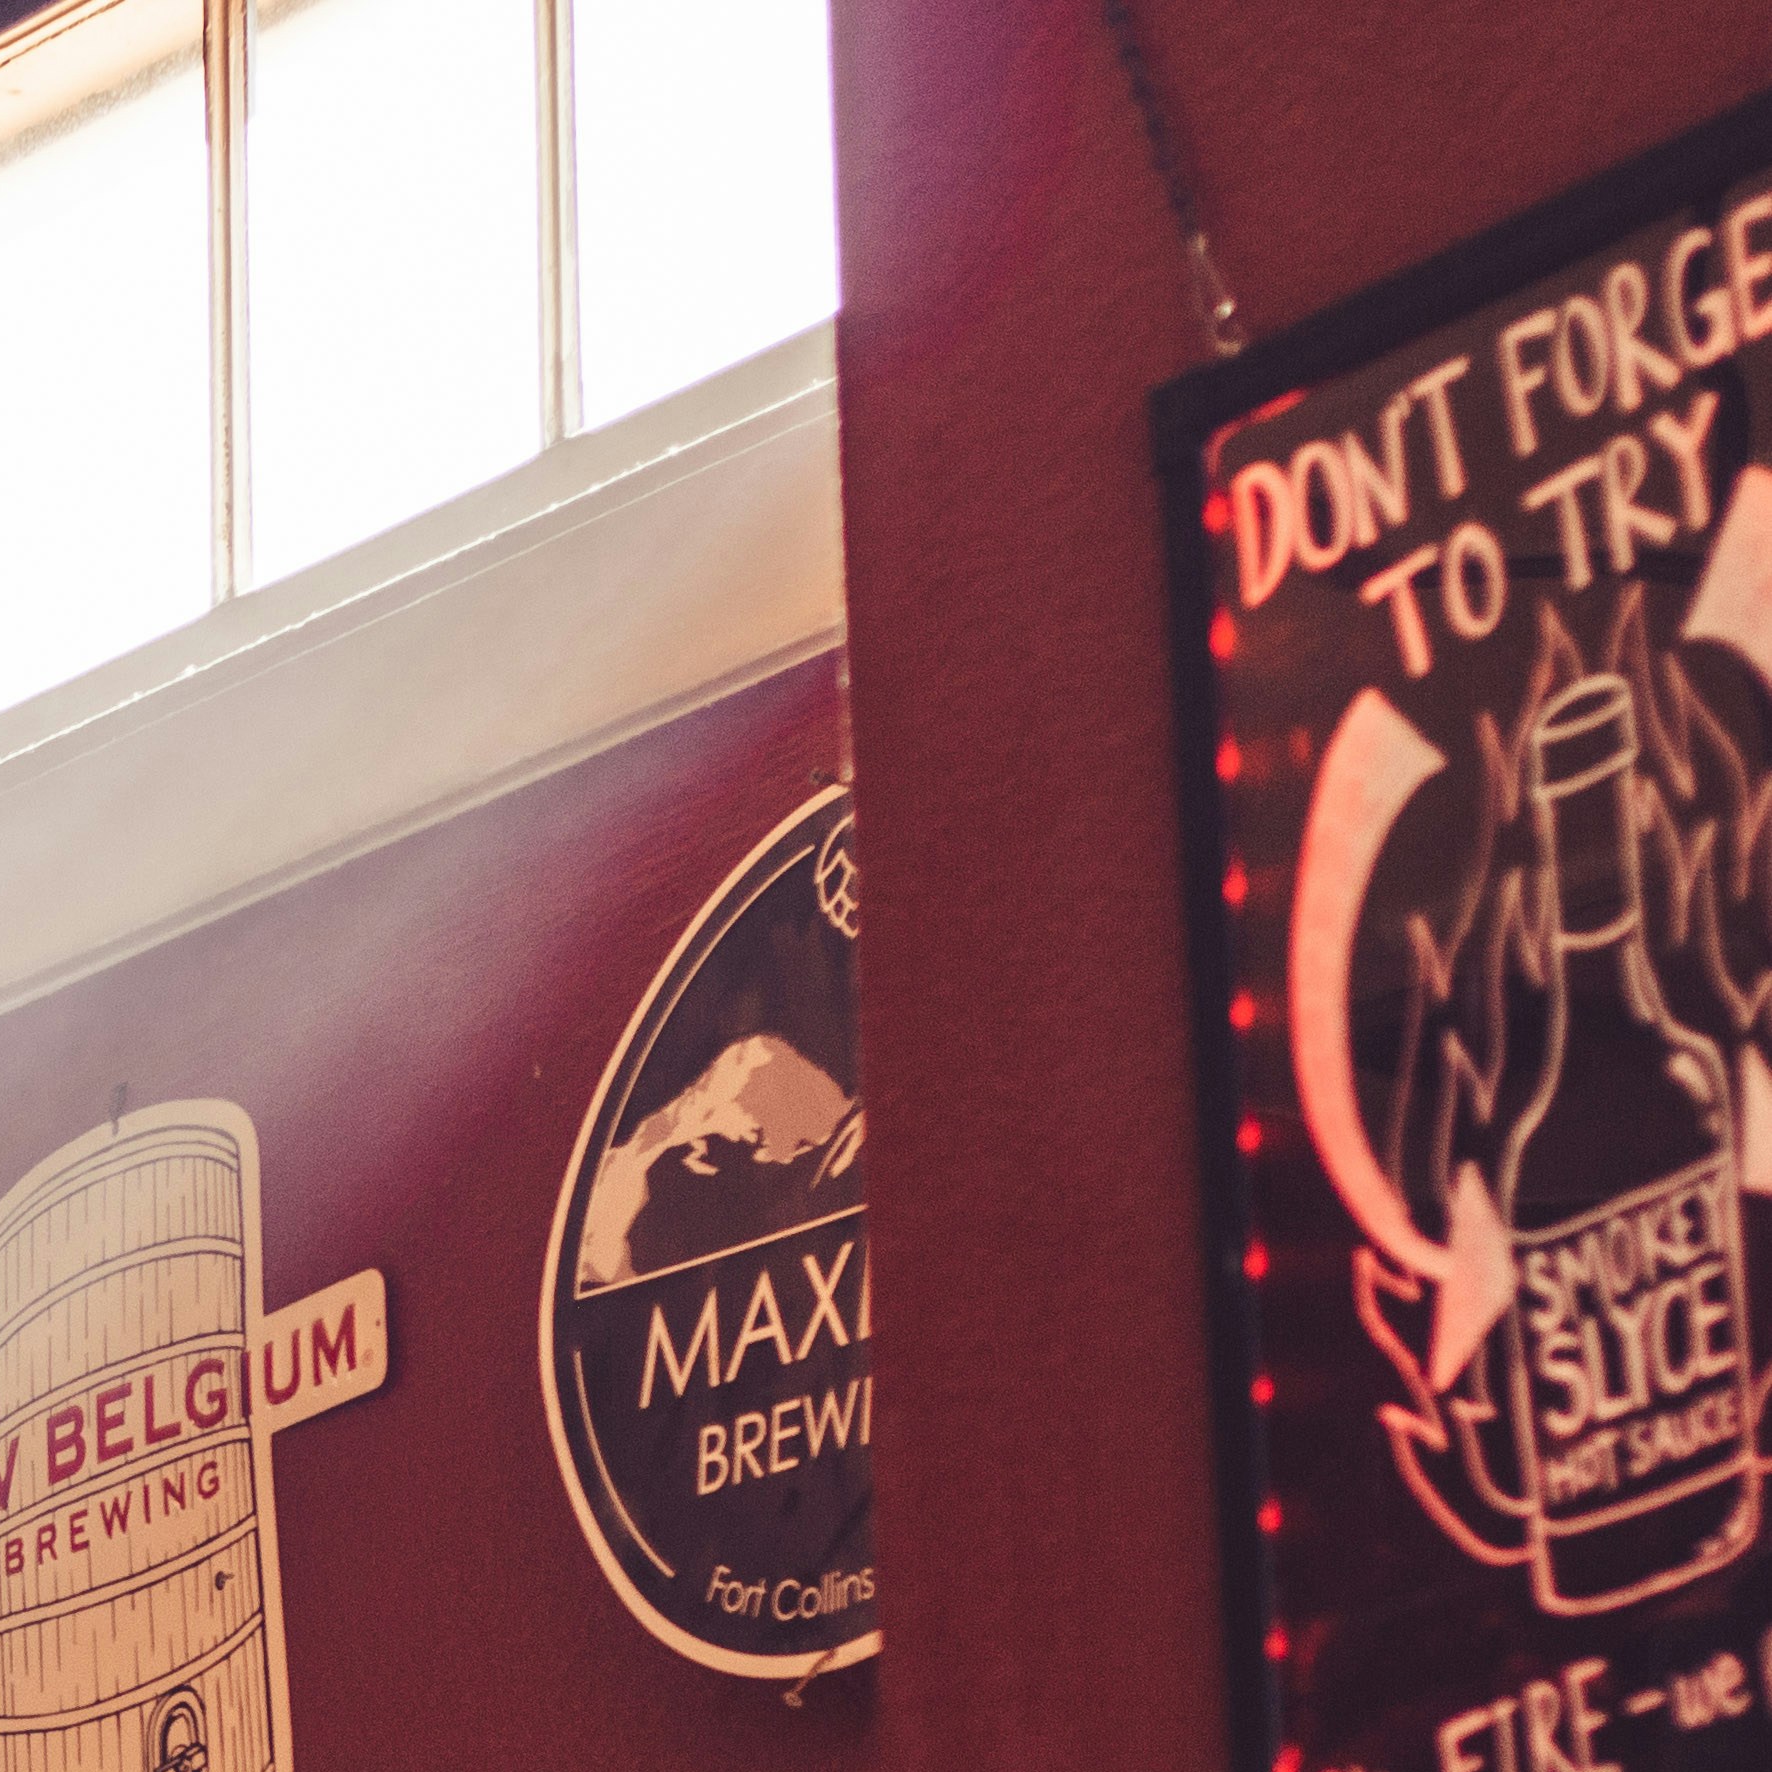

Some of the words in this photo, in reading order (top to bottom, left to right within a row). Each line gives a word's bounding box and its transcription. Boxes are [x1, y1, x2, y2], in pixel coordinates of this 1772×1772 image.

[1360, 522, 1507, 680] TO
[1521, 390, 1721, 592] TRY
[46, 1306, 358, 1487] BELGIUM
[4, 1460, 223, 1576] BREWING
[706, 1565, 767, 1620] Fort
